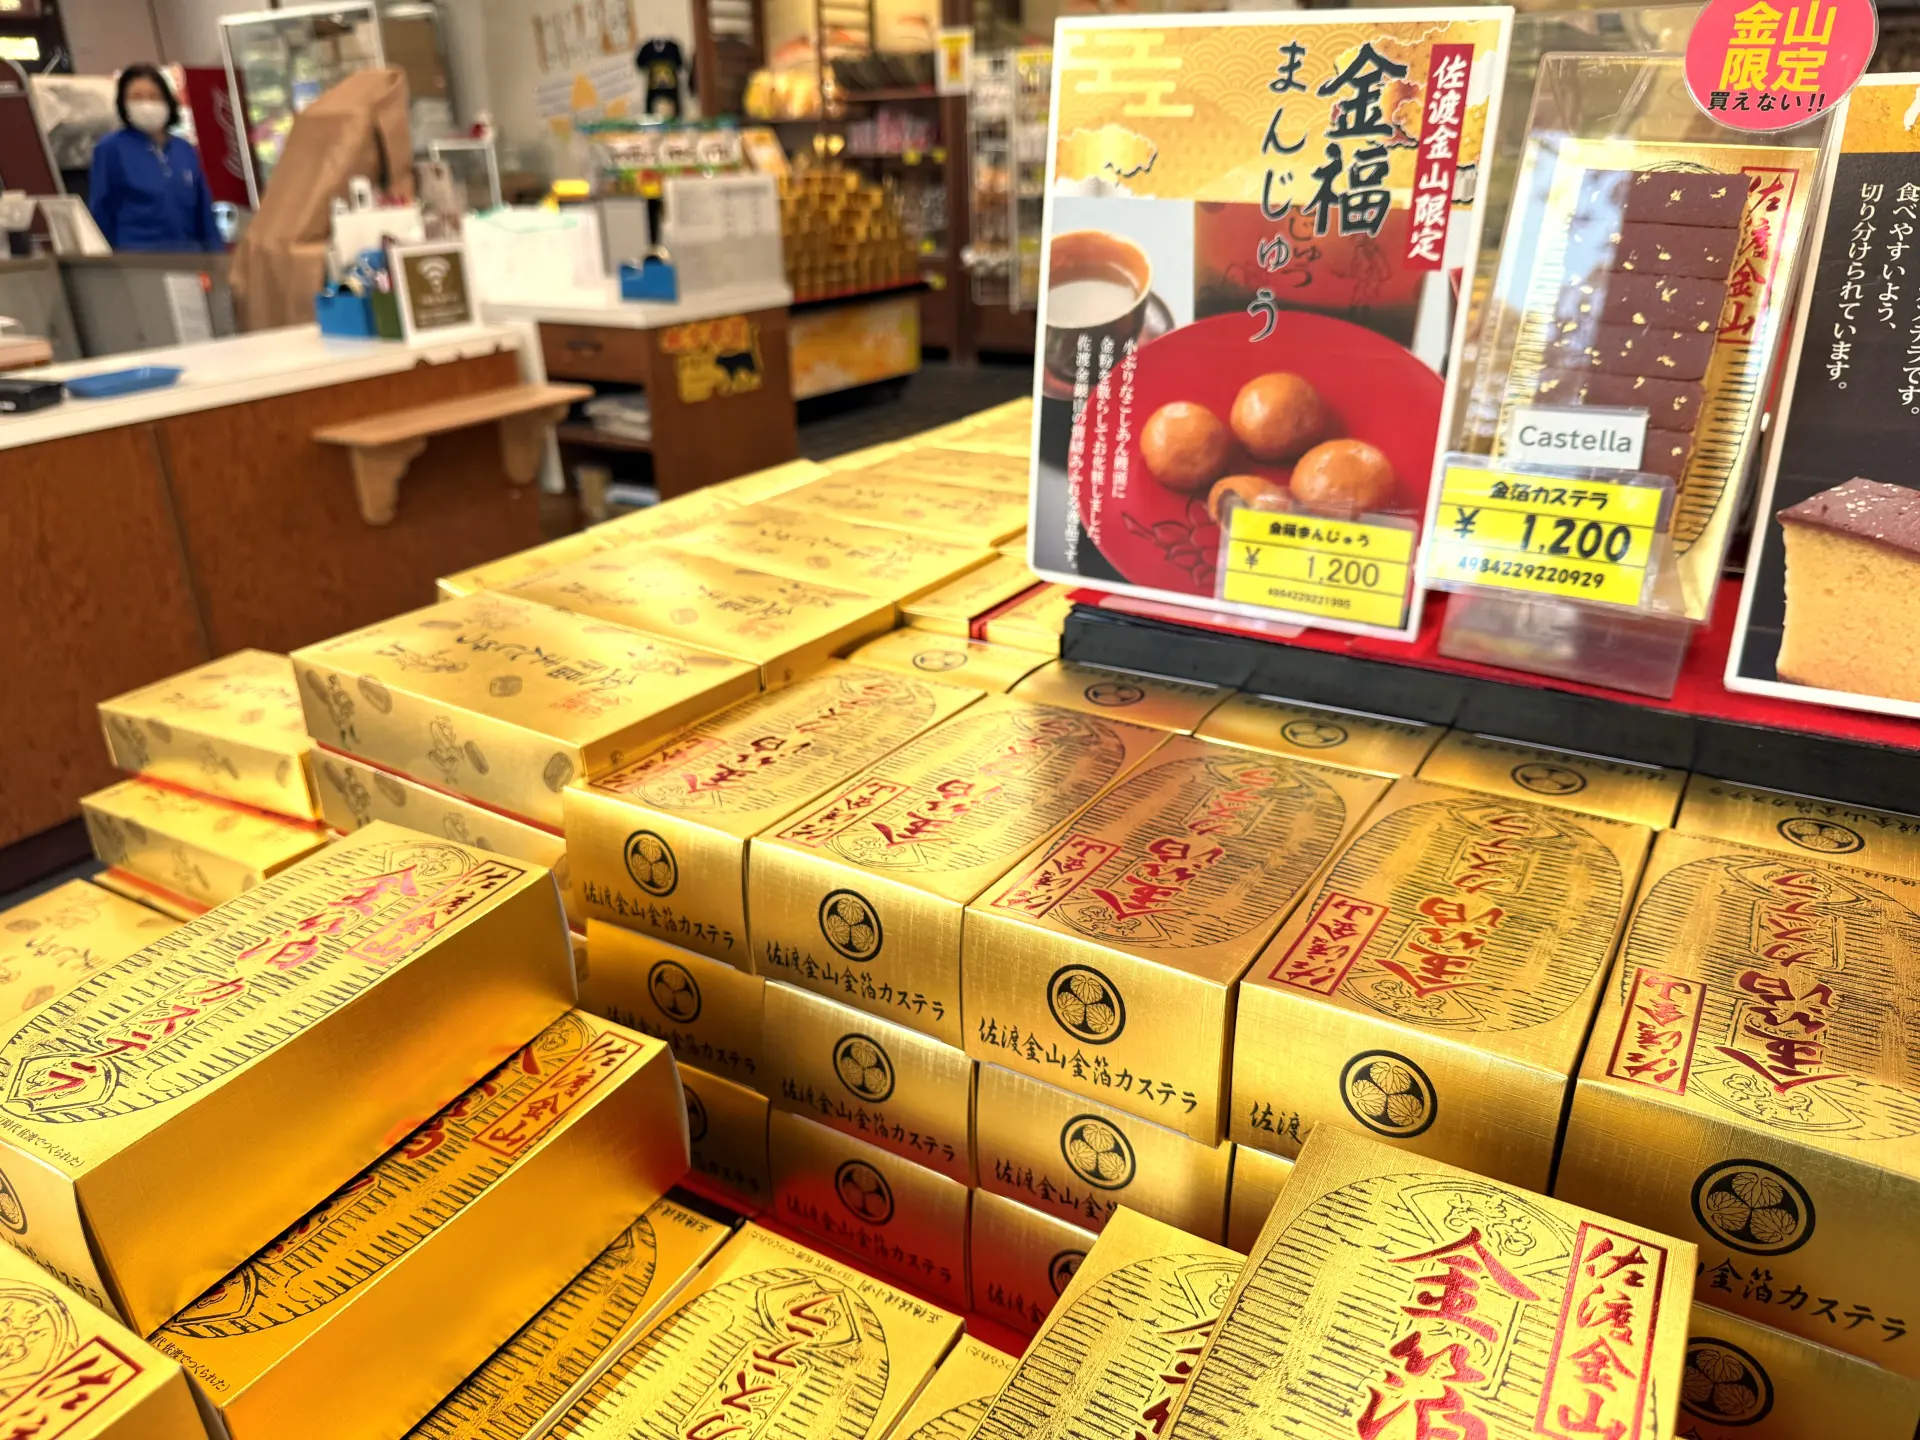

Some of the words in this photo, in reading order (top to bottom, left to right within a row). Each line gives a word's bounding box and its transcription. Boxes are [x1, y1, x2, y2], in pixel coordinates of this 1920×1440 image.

[1729, 0, 1837, 45] 金山
[1718, 47, 1828, 92] 限定
[1303, 42, 1408, 237] 金福
[1407, 55, 1466, 261] 佐渡金山限定
[1247, 41, 1309, 342] まんじゅう
[1825, 183, 1884, 390] 切り分けられています。
[1878, 182, 1920, 329] 食べやすいよう、
[1518, 425, 1632, 453] Castella
[1453, 508, 1481, 538] ¥
[1521, 513, 1632, 563] 1,200
[1488, 481, 1610, 510] 金箔カステラ
[1245, 546, 1261, 569] ¥
[1307, 555, 1380, 588] 1,200
[1457, 556, 1606, 588] 4984229220929
[584, 880, 735, 950] 佐渡金山金箔カステラ
[1374, 814, 1531, 999] 金箔カステラ
[767, 940, 946, 1022] 佐渡金山金箔カステラ
[1714, 872, 1852, 1096] 金箔カステラ
[978, 1016, 1198, 1114] 佐渡金山金箔カステラ
[1622, 976, 1692, 1084] 佐渡金山
[489, 1040, 629, 1149] 佐渡金山
[781, 1078, 956, 1163] 佐渡金山金箔カステラ
[1250, 1100, 1312, 1145] 佐渡
[1556, 1235, 1650, 1440] 佐渡金山
[1697, 1256, 1909, 1343] 金箔カステラ
